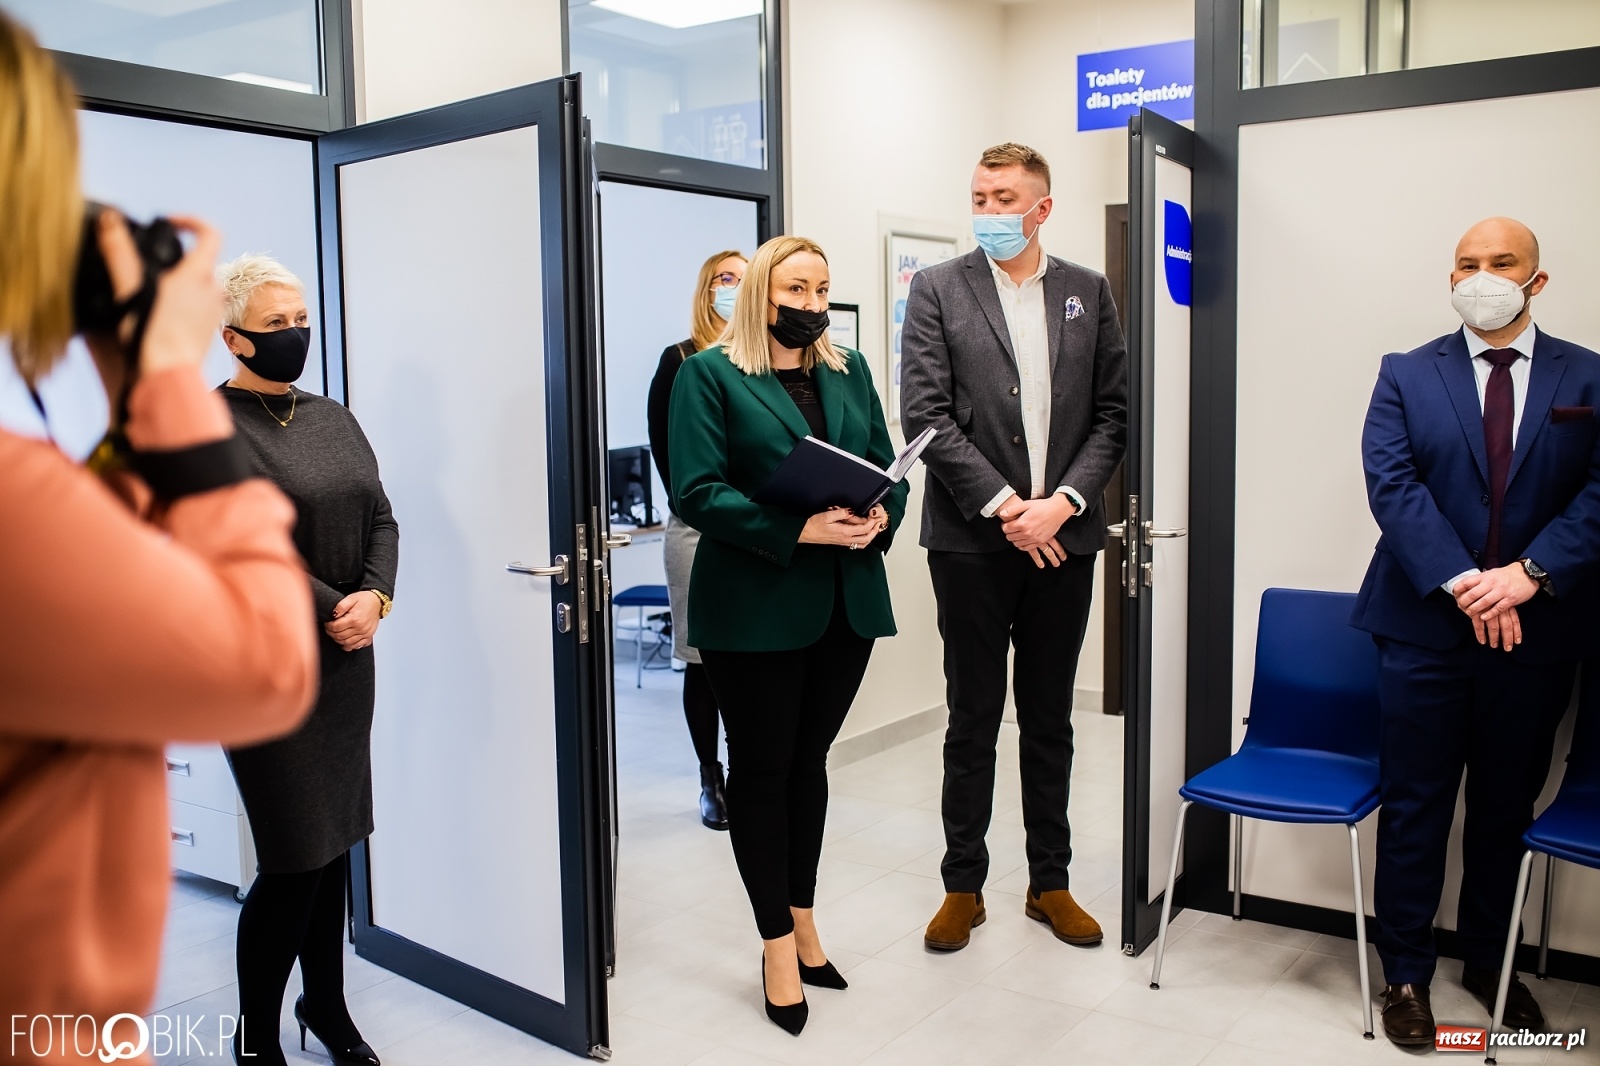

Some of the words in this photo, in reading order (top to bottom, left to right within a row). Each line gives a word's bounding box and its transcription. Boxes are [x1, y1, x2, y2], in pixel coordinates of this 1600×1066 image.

[1086, 68, 1145, 88] Toalety
[1086, 92, 1110, 109] dla
[1111, 83, 1193, 109] pacjentów
[898, 255, 918, 272] JAK
